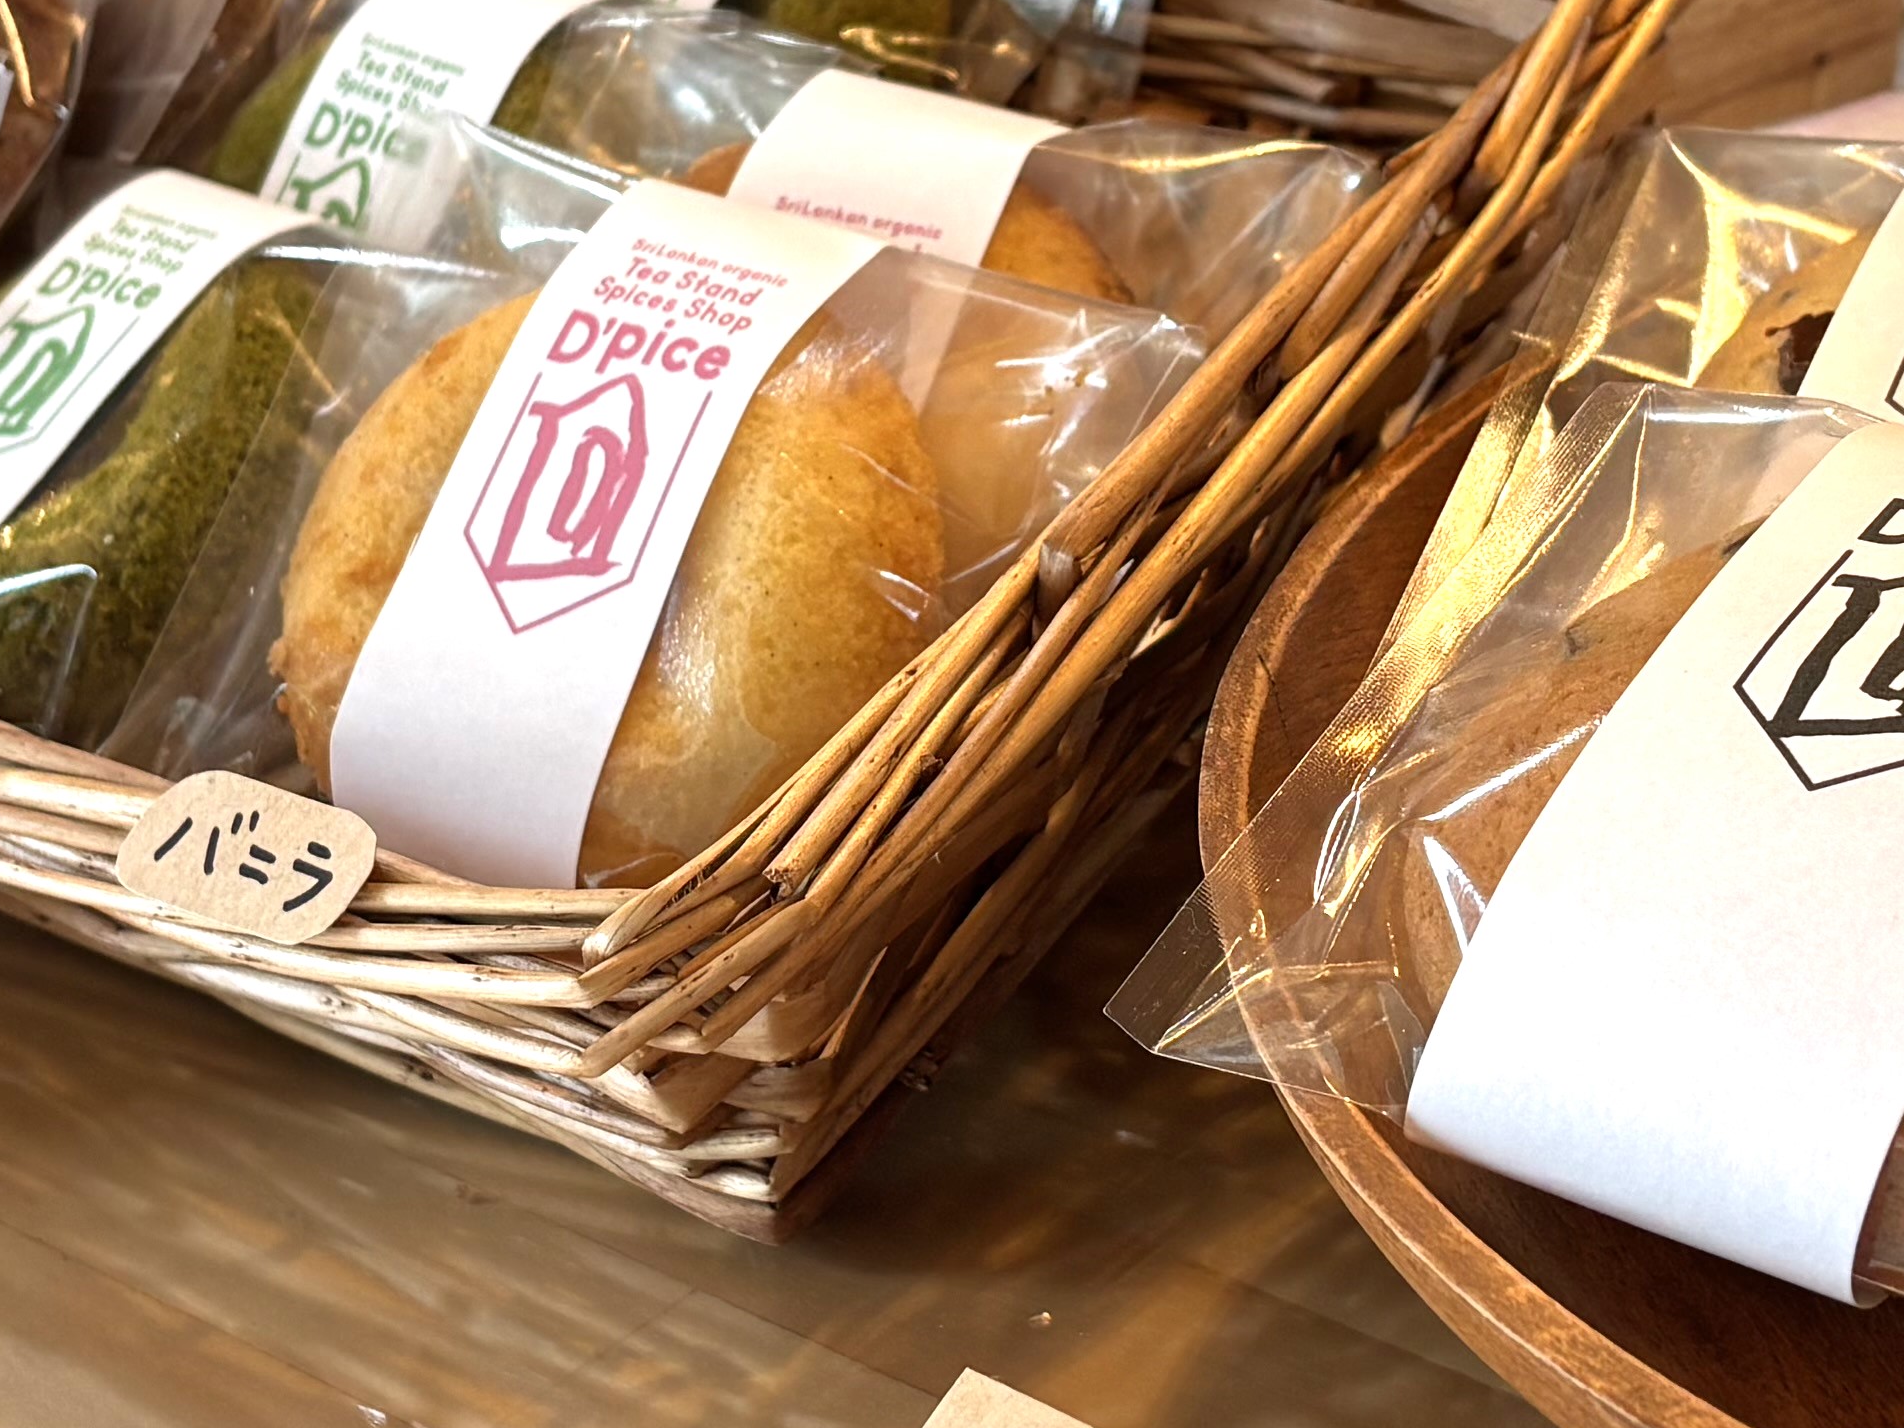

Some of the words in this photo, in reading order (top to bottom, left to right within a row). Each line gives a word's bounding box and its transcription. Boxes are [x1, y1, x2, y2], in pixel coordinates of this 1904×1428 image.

[358, 49, 388, 78] Tea
[389, 61, 451, 99] Stand
[872, 213, 944, 241] organic
[37, 258, 163, 309] D'pice
[593, 274, 679, 312] Spices
[681, 296, 755, 335] Shop
[623, 257, 671, 287] Tea
[675, 269, 764, 307] Stand
[546, 309, 732, 381] D'pice
[152, 810, 334, 913] バニラ
